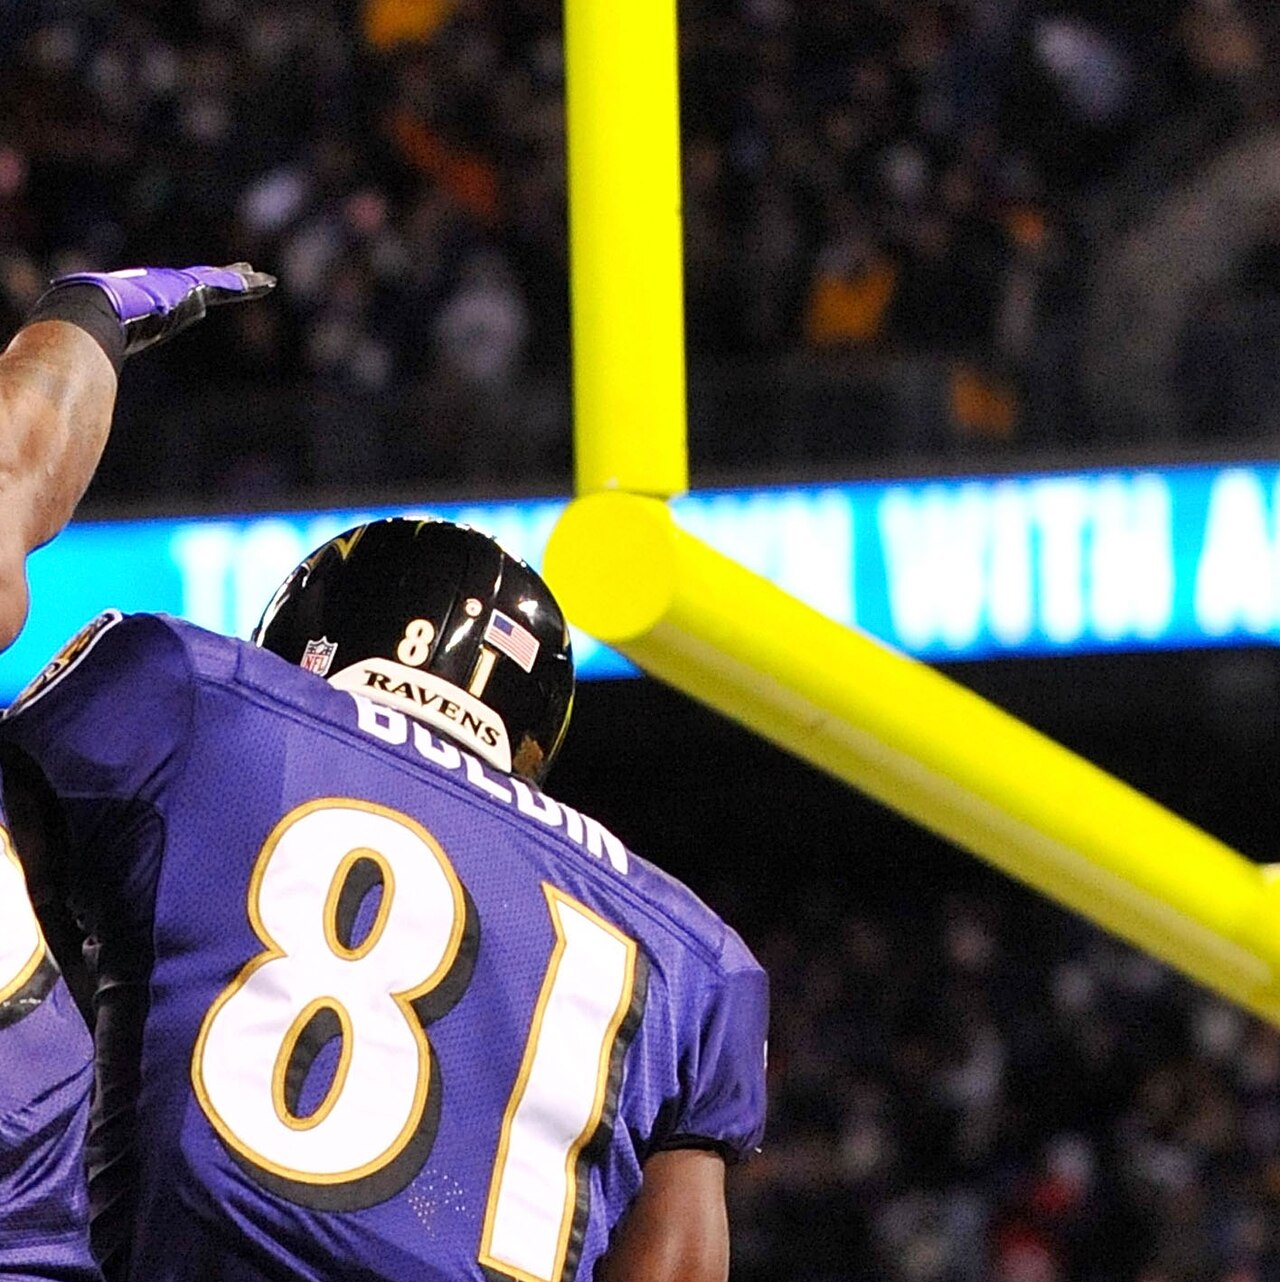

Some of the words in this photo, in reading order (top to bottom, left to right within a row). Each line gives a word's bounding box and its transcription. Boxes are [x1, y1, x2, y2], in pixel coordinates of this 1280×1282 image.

[876, 470, 1173, 650] WITH
[1196, 465, 1280, 637] A
[364, 669, 501, 748] RAVENS
